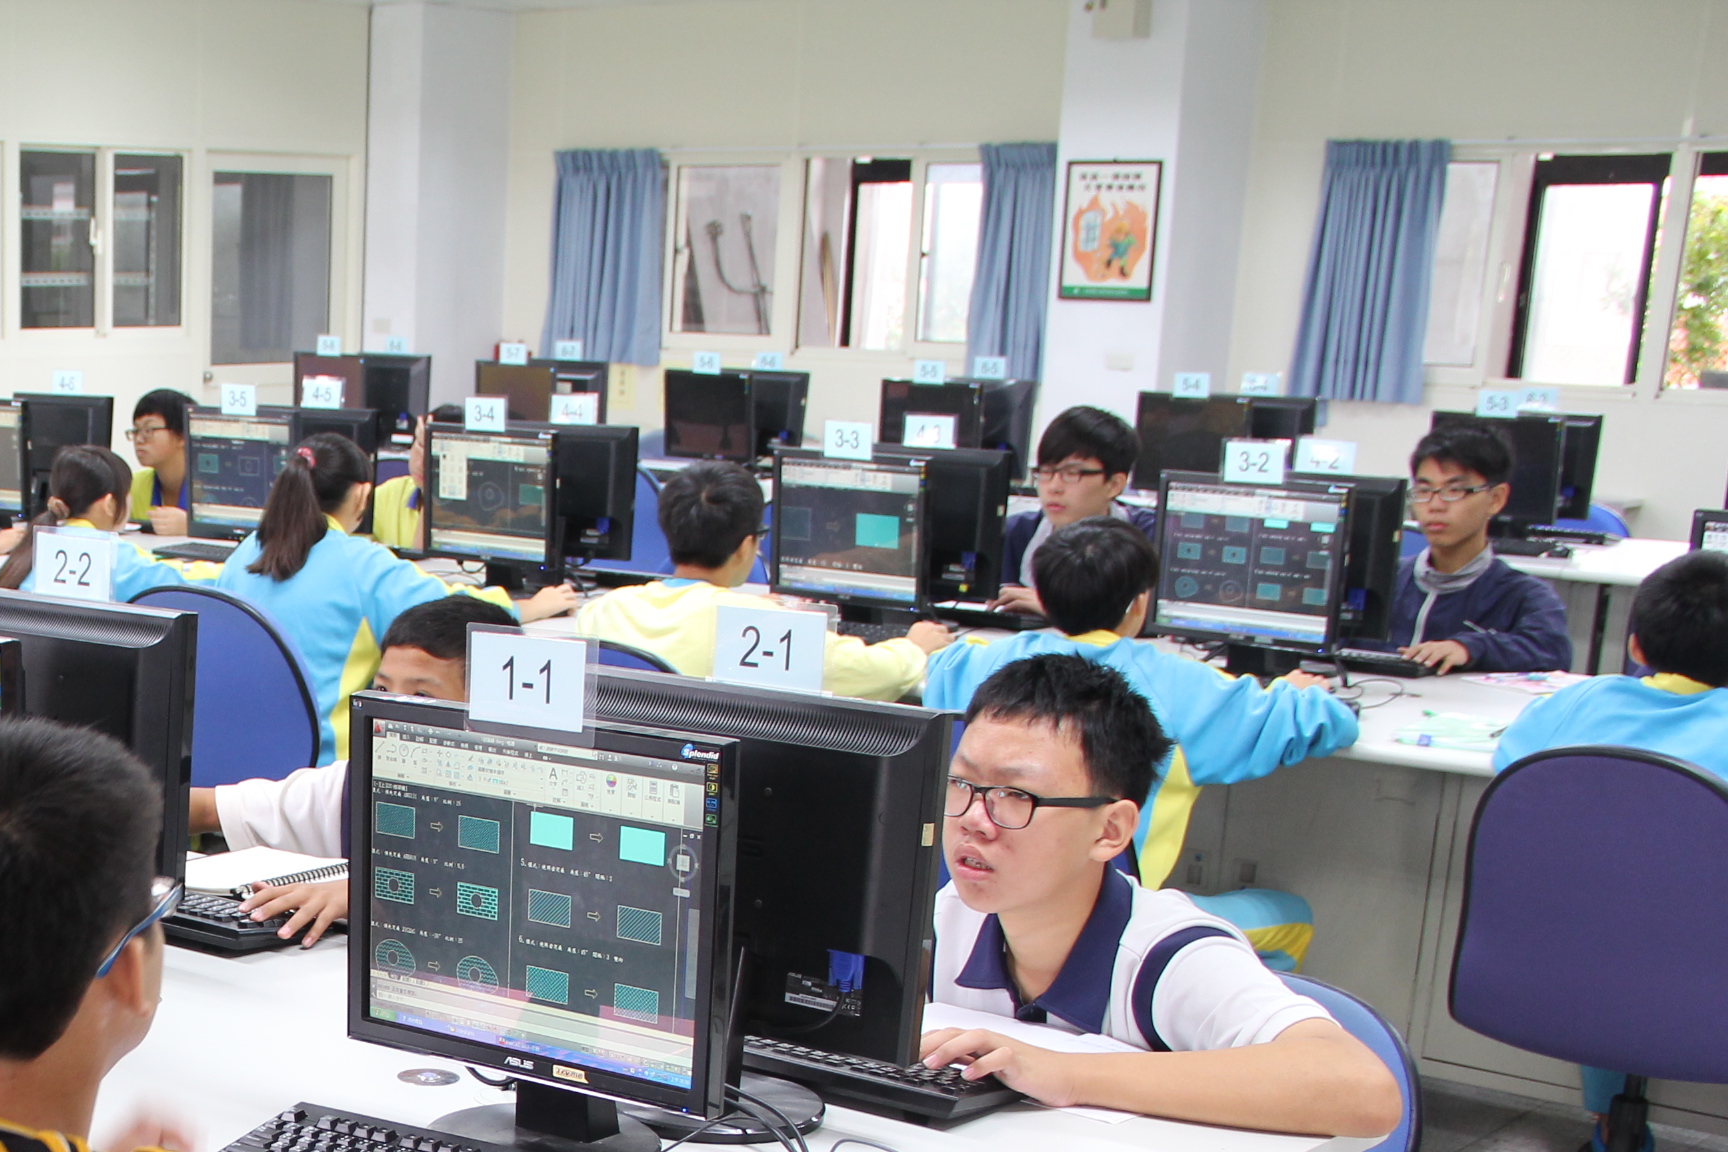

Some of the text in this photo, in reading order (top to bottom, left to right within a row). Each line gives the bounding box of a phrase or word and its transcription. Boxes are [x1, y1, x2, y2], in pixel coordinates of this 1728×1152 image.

[59, 375, 75, 391] 4-6
[229, 390, 247, 407] 3-5
[312, 385, 332, 402] 4-5
[561, 402, 583, 420] 4-4
[1485, 394, 1509, 412] 5-3
[474, 404, 495, 423] 3-4
[835, 429, 860, 449] 3-3
[916, 423, 942, 444] 43
[1238, 450, 1270, 473] 3-2
[52, 549, 92, 588] 2-2
[738, 624, 793, 672] 2-1
[501, 655, 552, 705] 1-1
[681, 746, 720, 761] Splendid
[503, 1056, 535, 1070] ASUS
